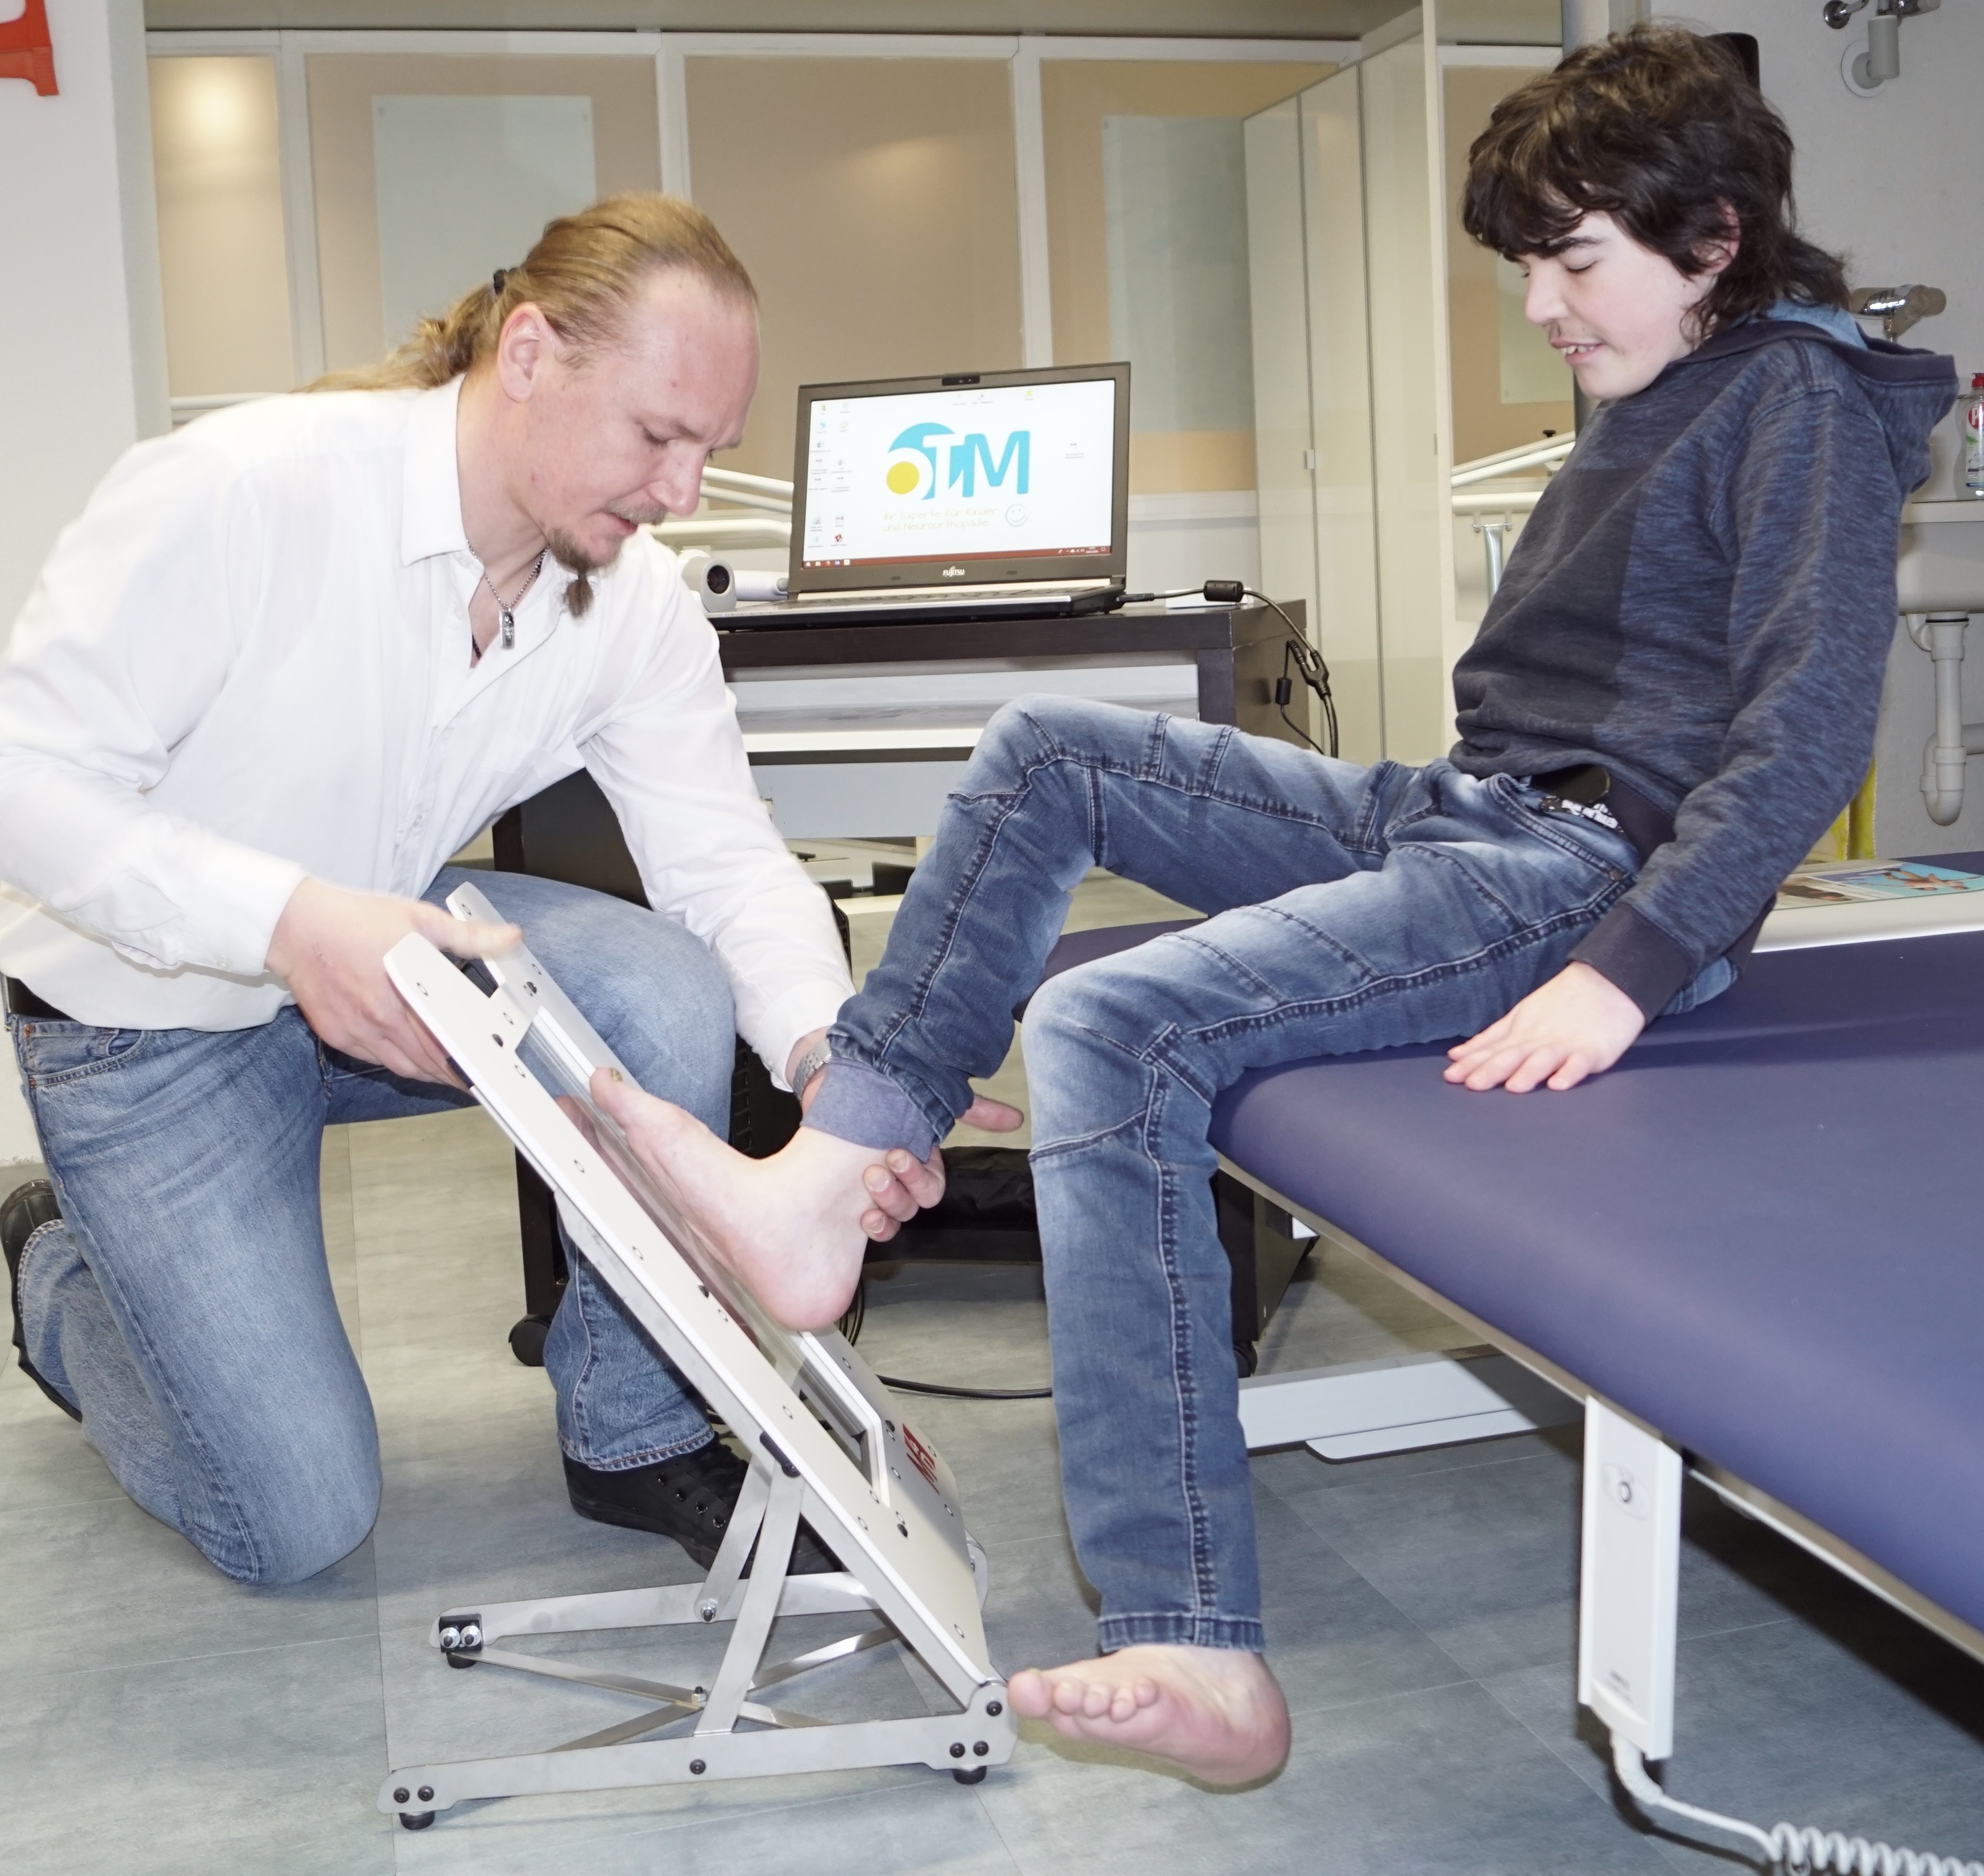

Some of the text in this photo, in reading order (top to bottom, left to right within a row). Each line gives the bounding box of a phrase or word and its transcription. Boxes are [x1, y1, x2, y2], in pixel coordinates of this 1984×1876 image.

[884, 512, 897, 520] Ihr
[900, 510, 941, 522] Experte
[945, 508, 962, 519] für
[883, 523, 900, 532] und
[942, 566, 965, 577] FUJITSU
